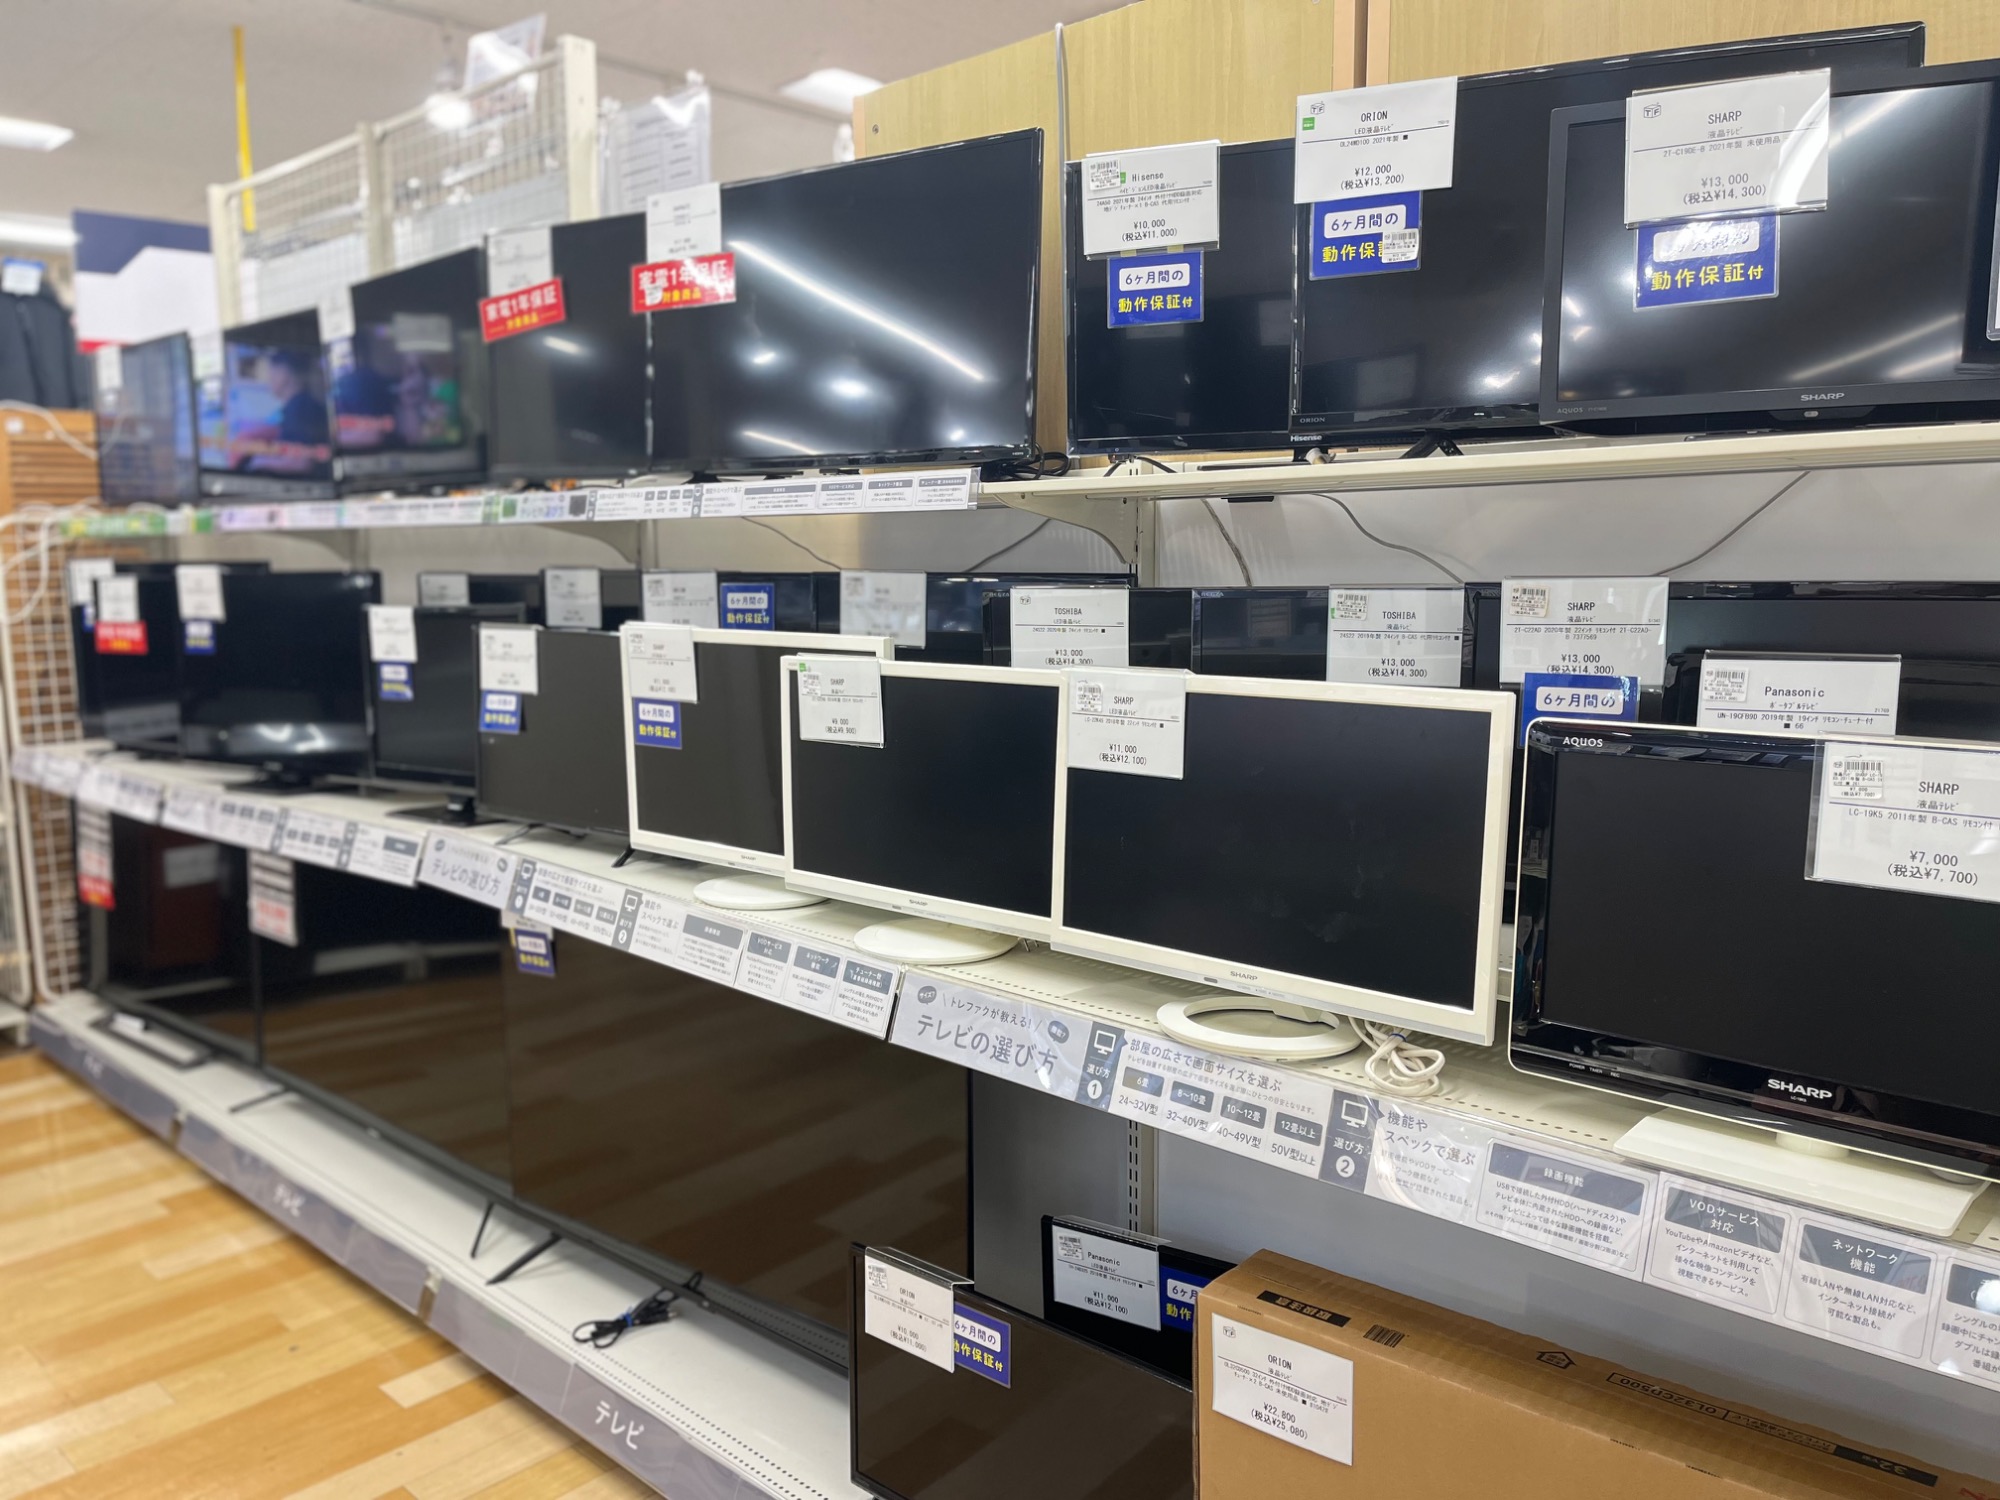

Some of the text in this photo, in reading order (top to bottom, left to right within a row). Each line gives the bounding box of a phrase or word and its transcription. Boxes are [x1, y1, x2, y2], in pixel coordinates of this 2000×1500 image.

[1361, 111, 1388, 122] ORION
[1708, 111, 1741, 124] SHARP
[1373, 135, 1399, 144] 2021年製
[1709, 141, 1742, 152] 2021年製
[1747, 137, 1780, 147] 未使用品
[1132, 172, 1163, 181] Hisense
[1355, 165, 1391, 177] ¥12,000
[1341, 174, 1404, 191] (税込¥13,200)
[1701, 173, 1748, 187] ¥13,000
[1684, 185, 1767, 205] (税込¥14,300)
[1134, 219, 1165, 229] ¥10,000
[1122, 228, 1177, 242] (税込¥11,000)
[1322, 241, 1382, 262] 動作保
[1651, 263, 1763, 291] 動作保証付
[1118, 295, 1193, 313] 動作保証付
[1800, 392, 1844, 401] SHARP
[1568, 602, 1595, 611] SHARP
[727, 613, 769, 623] 動作保証付
[1561, 654, 1600, 663] ¥13,000
[1368, 668, 1427, 678] (税込¥14,300)
[1547, 666, 1614, 674] (税込¥14,300)
[1765, 686, 1824, 698] Panasonic
[1114, 696, 1134, 705] SHARP
[1761, 714, 1793, 722] 2019年製
[639, 724, 676, 738] 動作保証付
[1109, 744, 1137, 753] ¥11,000
[1563, 736, 1603, 748] AQUOS
[1099, 753, 1146, 765] (税込¥12,100)
[1918, 782, 1959, 795] SHARP
[1917, 800, 1959, 811] 液晶テレビ
[1849, 808, 1882, 818] LC-19K5
[1888, 812, 1927, 824] 2011年製
[1932, 817, 1958, 826] B-CAS
[1910, 851, 1958, 867] ¥7,000
[432, 859, 502, 896] テレビの選び方
[1888, 864, 1978, 885] (税込¥7,700)
[909, 899, 928, 907] SHARP
[1230, 971, 1258, 981] SHARP
[918, 1014, 1058, 1077] テレビの選び方
[1086, 1064, 1110, 1078] 選び方
[1130, 1039, 1283, 1092] 部屋の広さで画面サイズを選ぶ
[1767, 1078, 1832, 1099] SHARP
[1281, 1120, 1316, 1139] 12畳以上
[1387, 1111, 1428, 1132] 機能や
[1333, 1137, 1364, 1155] 選び方
[1385, 1130, 1475, 1166] スペックで選ぶ
[1271, 1143, 1316, 1166] 50V型以上
[1544, 1168, 1584, 1187] 録画機能
[1690, 1198, 1760, 1227] VODサービス
[1710, 1218, 1734, 1233] 対応
[1665, 1227, 1775, 1267] YouTubeやAmazonビデオなど、
[1832, 1239, 1898, 1265] ネットワーク
[1088, 1252, 1120, 1266] Panasonic
[1676, 1244, 1760, 1274] インターネットを利用して
[1850, 1257, 1876, 1274] 機能
[1674, 1255, 1756, 1286] 様々な映像コンテンツを
[1678, 1268, 1748, 1297] 視聴できるサービス。
[900, 1287, 915, 1299] ORION
[1093, 1291, 1119, 1303] ¥11,000
[1801, 1274, 1917, 1315] 有線LANや無線LAN対応など、
[1084, 1297, 1128, 1315] (税込¥12,100)
[1166, 1303, 1192, 1321] 動作
[1817, 1293, 1896, 1321] インターネット接続が
[1827, 1307, 1882, 1331] 可能な製品も。
[898, 1325, 919, 1340] ¥10,000
[890, 1331, 927, 1353] (税込¥11,000)
[1268, 1354, 1292, 1370] ORION
[1264, 1402, 1296, 1423] ¥22,800
[595, 1400, 644, 1450] テレビ
[1251, 1409, 1308, 1440] (税込¥25,080)
